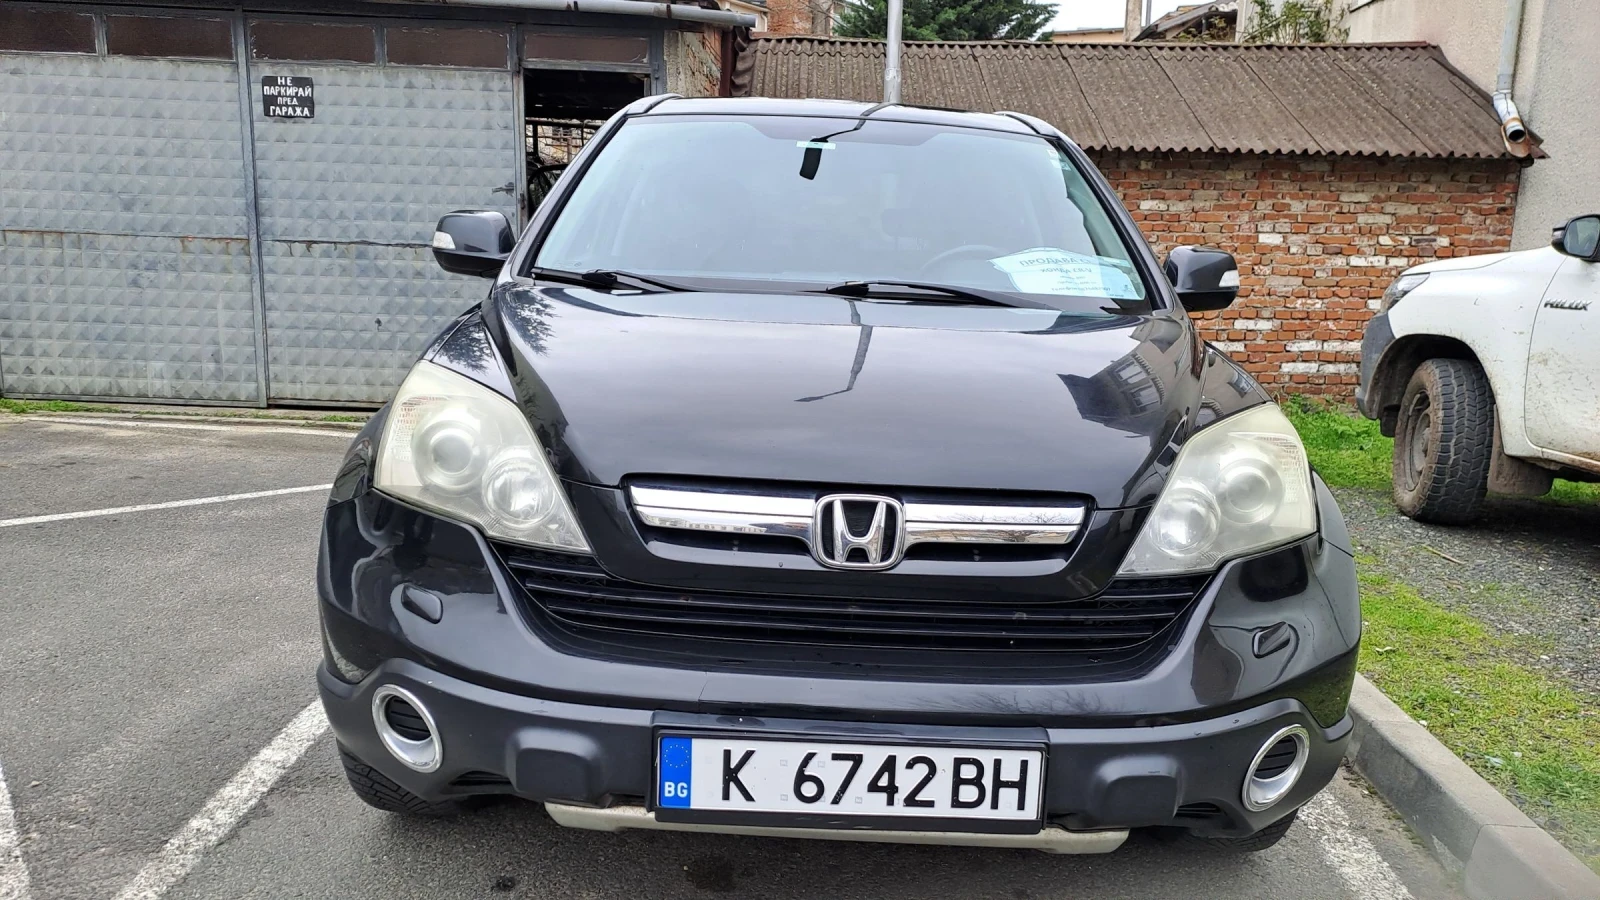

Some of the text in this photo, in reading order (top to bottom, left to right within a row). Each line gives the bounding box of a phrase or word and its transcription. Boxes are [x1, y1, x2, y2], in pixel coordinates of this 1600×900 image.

[277, 76, 293, 86] НЕ
[263, 85, 312, 97] ПАРКИРАЙ
[277, 97, 299, 105] ПРЕД
[269, 106, 310, 117] ГАРАЖА
[1019, 257, 1078, 266] ПРОДАВА
[1543, 299, 1592, 311] HILUX
[720, 748, 757, 802] K
[793, 751, 936, 808] 6742
[664, 781, 688, 798] BG
